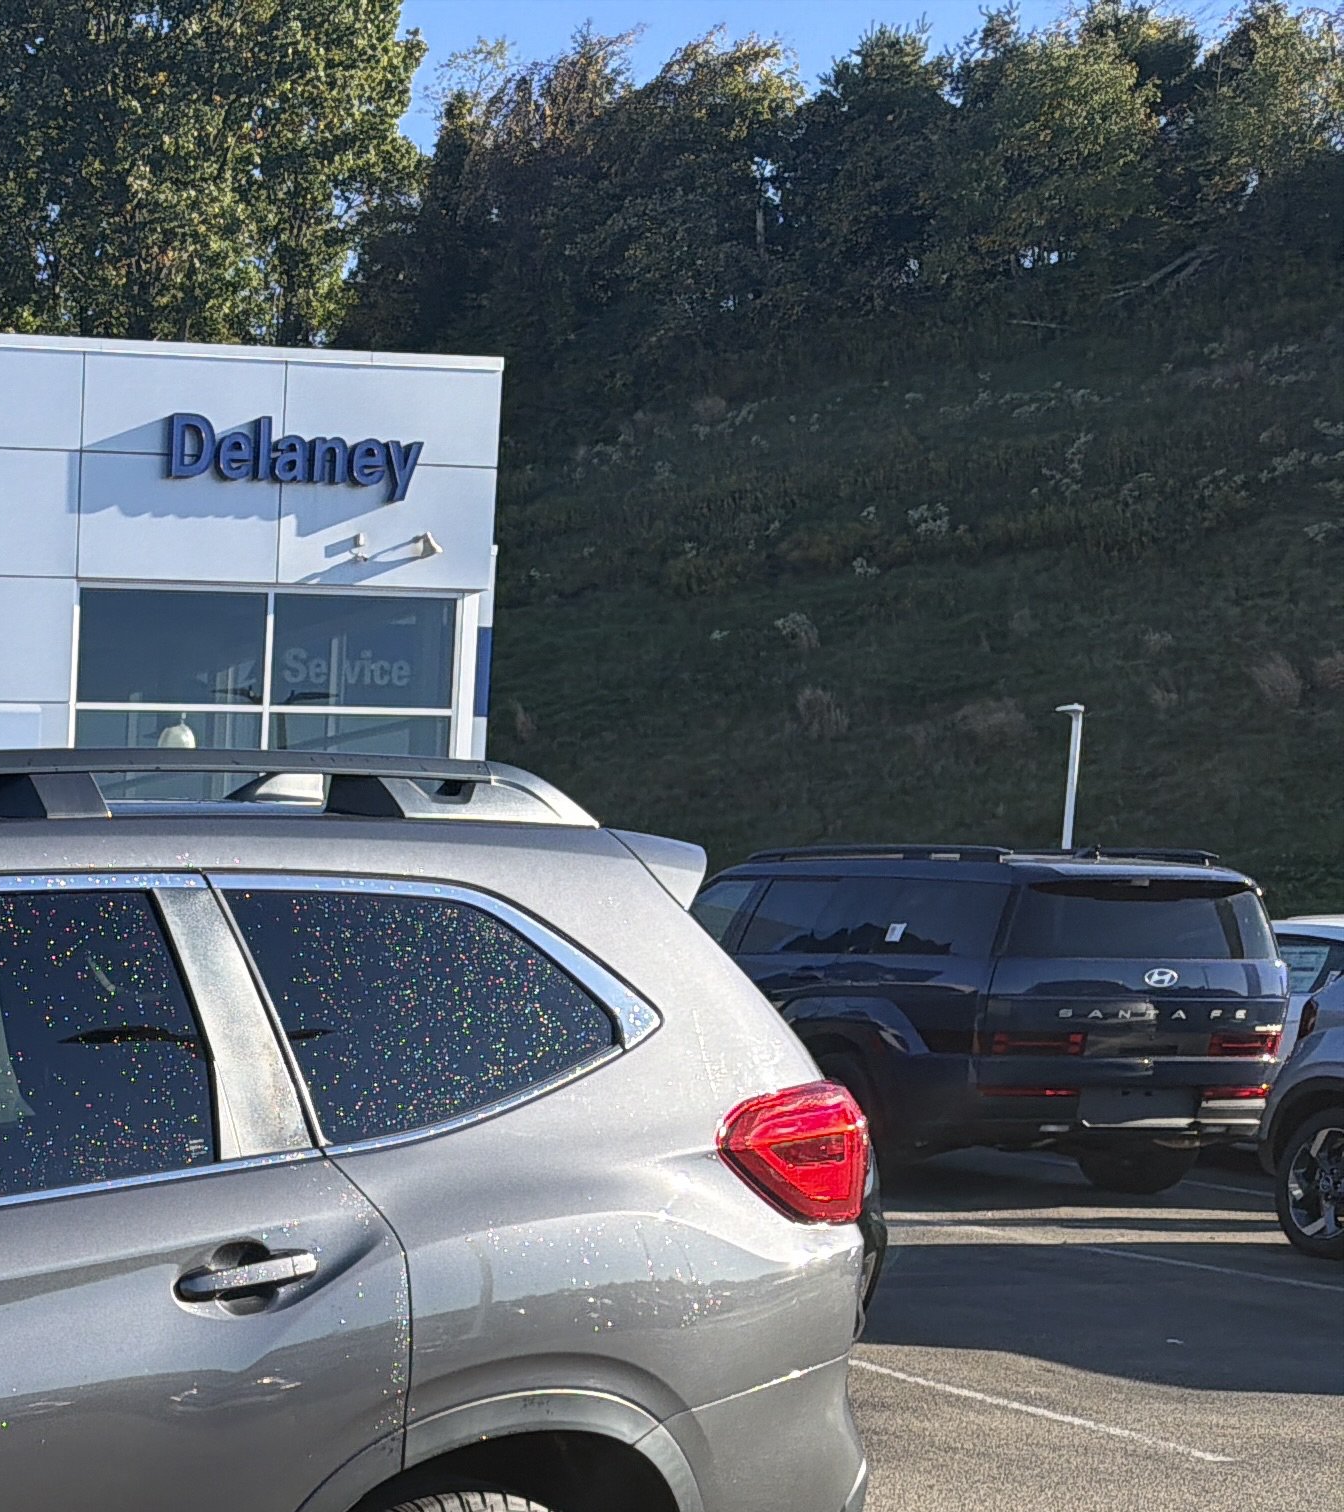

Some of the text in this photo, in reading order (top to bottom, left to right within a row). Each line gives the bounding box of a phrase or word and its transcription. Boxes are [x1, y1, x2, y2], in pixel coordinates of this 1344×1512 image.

[169, 412, 424, 502] Delaney
[283, 647, 411, 686] Sevice
[1058, 1008, 1247, 1021] SANTA FE
